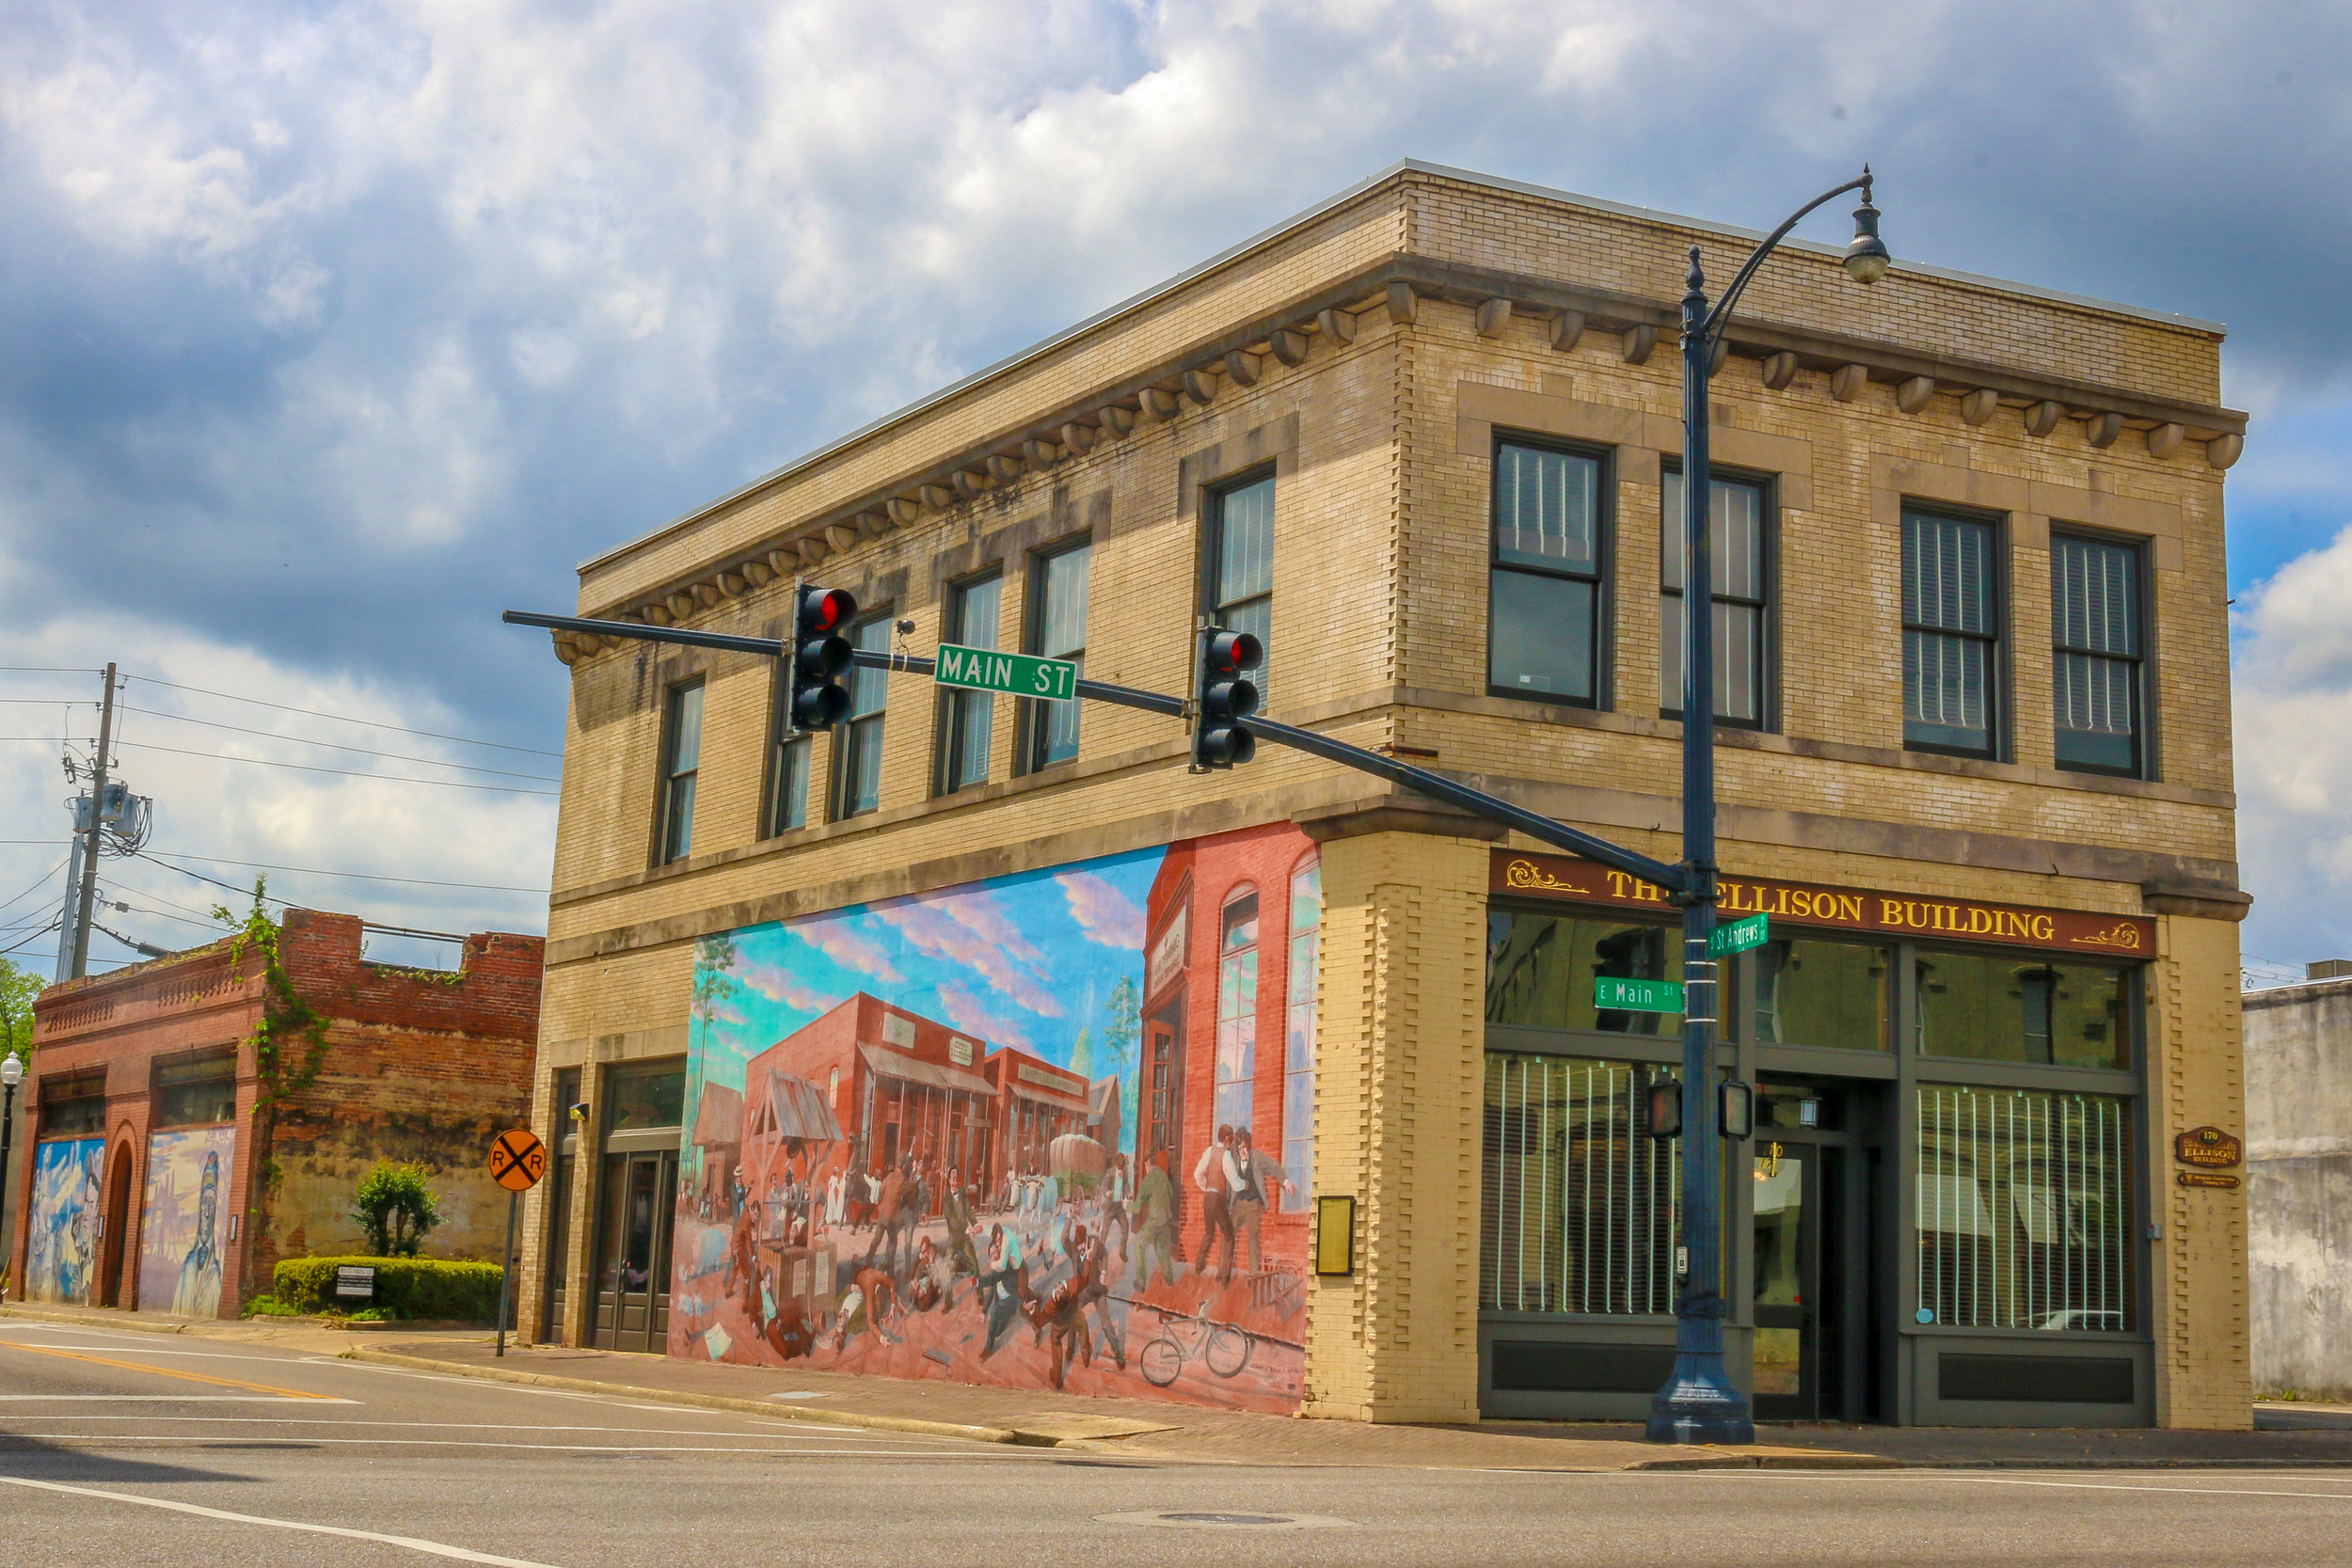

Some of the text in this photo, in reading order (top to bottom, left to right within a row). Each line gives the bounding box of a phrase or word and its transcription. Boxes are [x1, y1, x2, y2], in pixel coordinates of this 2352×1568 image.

[941, 650, 1070, 695] MAIN ST
[1606, 870, 2056, 942] TH ELLISON BUILDING
[1716, 929, 1724, 950] St
[1727, 924, 1758, 948] Andrews
[1600, 983, 1674, 1004] E Main St
[2203, 1132, 2218, 1140] 170
[492, 1150, 542, 1170] R R
[2185, 1148, 2236, 1160] ELLISON
